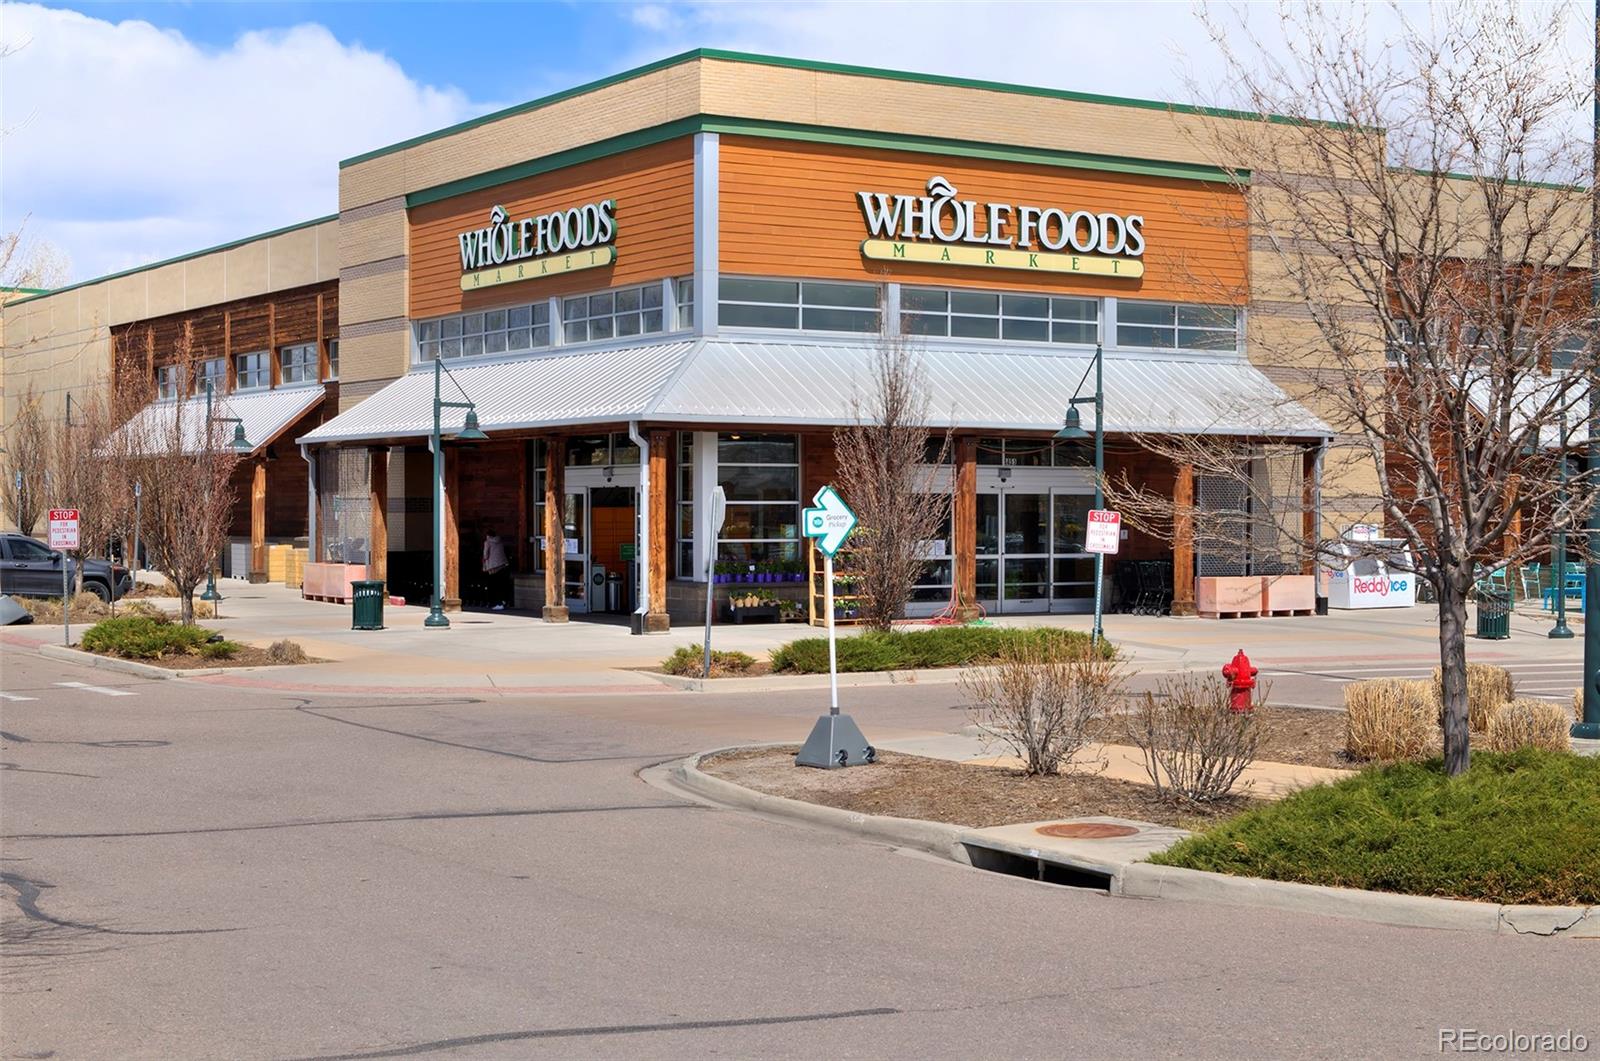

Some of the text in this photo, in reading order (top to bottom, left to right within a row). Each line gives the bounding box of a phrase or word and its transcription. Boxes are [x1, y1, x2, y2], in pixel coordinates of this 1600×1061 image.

[857, 176, 1146, 257] WHOLE FOODS
[458, 199, 617, 271] WHOLE FOODS
[473, 250, 597, 287] MARKET
[893, 242, 1121, 274] MARKET
[53, 511, 75, 520] STOP
[1093, 512, 1115, 522] STOP
[1353, 576, 1390, 597] Reddy
